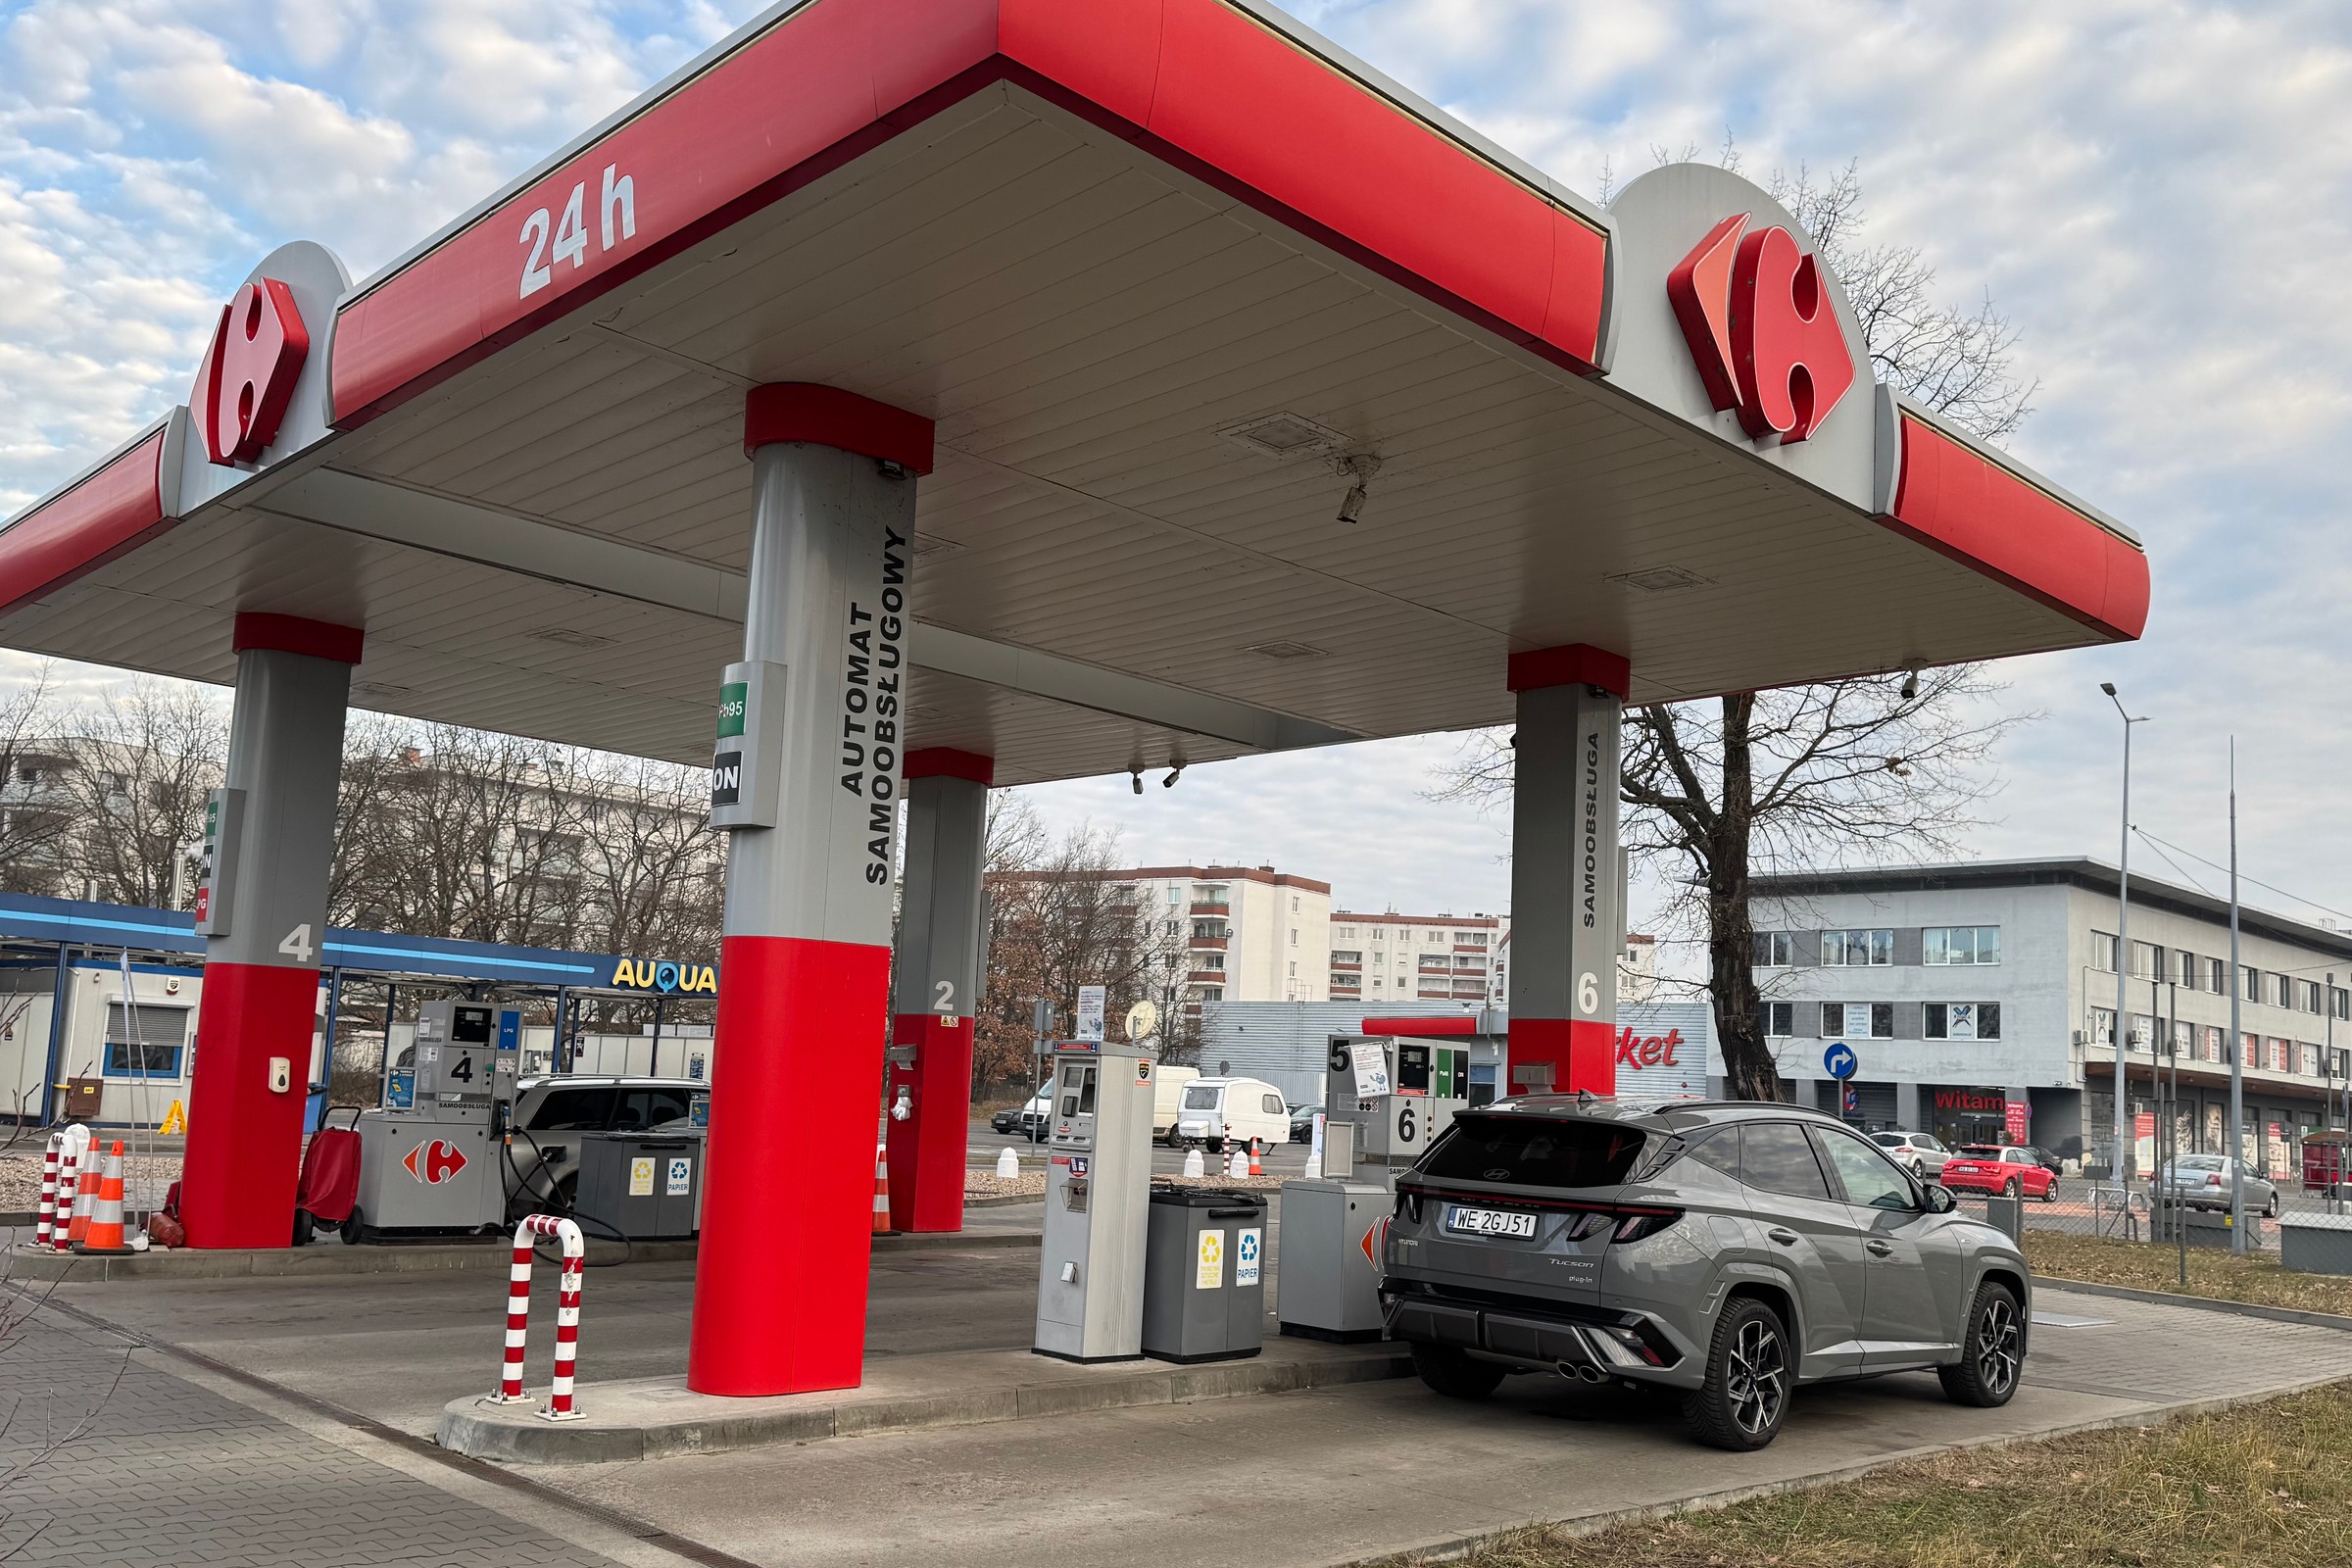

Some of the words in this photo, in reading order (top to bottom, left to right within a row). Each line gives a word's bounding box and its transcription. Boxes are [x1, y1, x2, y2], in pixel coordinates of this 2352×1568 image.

[519, 180, 588, 300] 24
[601, 162, 636, 252] h
[718, 701, 743, 718] Pb95
[841, 602, 872, 797] AUTOMAT
[865, 526, 906, 885] SAMOOBSŁUGOWY
[713, 766, 739, 791] ON
[1584, 732, 1599, 928] SAMOOBSŁUGA
[197, 898, 207, 910] PG
[278, 923, 314, 962] 4
[612, 958, 717, 994] AUQUA
[933, 980, 955, 1011] 2
[1578, 971, 1599, 1015] 6
[1330, 1040, 1350, 1072] 5
[1616, 1026, 1685, 1070] ket
[451, 1057, 472, 1083] 4
[1935, 1090, 2005, 1111] Witam
[1398, 1108, 1416, 1143] 6
[1457, 1209, 1479, 1229] WE
[1481, 1212, 1530, 1235] 2GJ51
[1238, 1267, 1257, 1279] PAPIER
